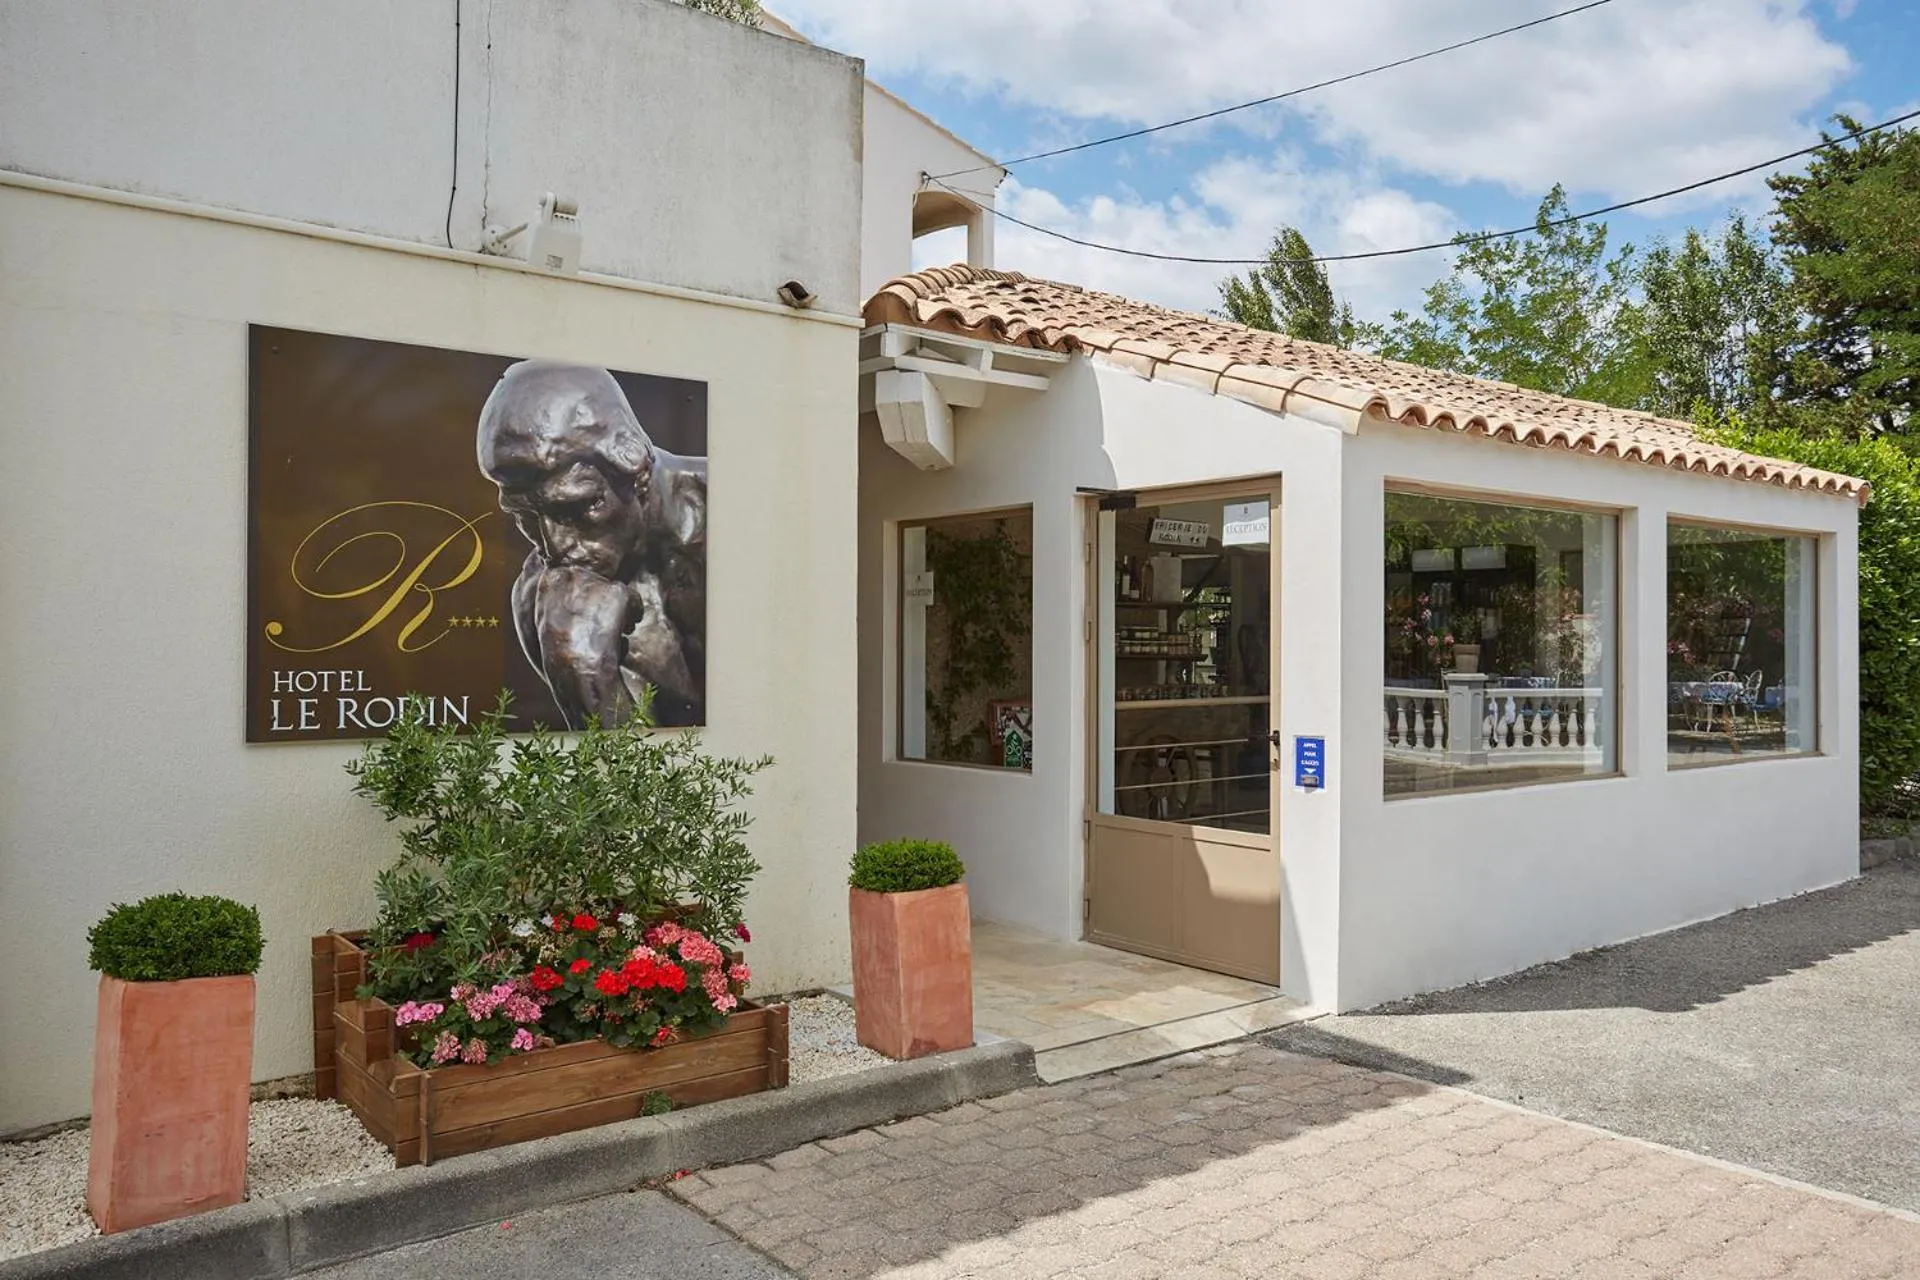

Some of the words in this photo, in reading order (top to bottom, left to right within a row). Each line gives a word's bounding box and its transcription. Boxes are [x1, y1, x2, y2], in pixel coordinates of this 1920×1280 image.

[272, 670, 372, 692] HOTEL
[270, 698, 321, 731] LE
[335, 696, 470, 729] RODIN
